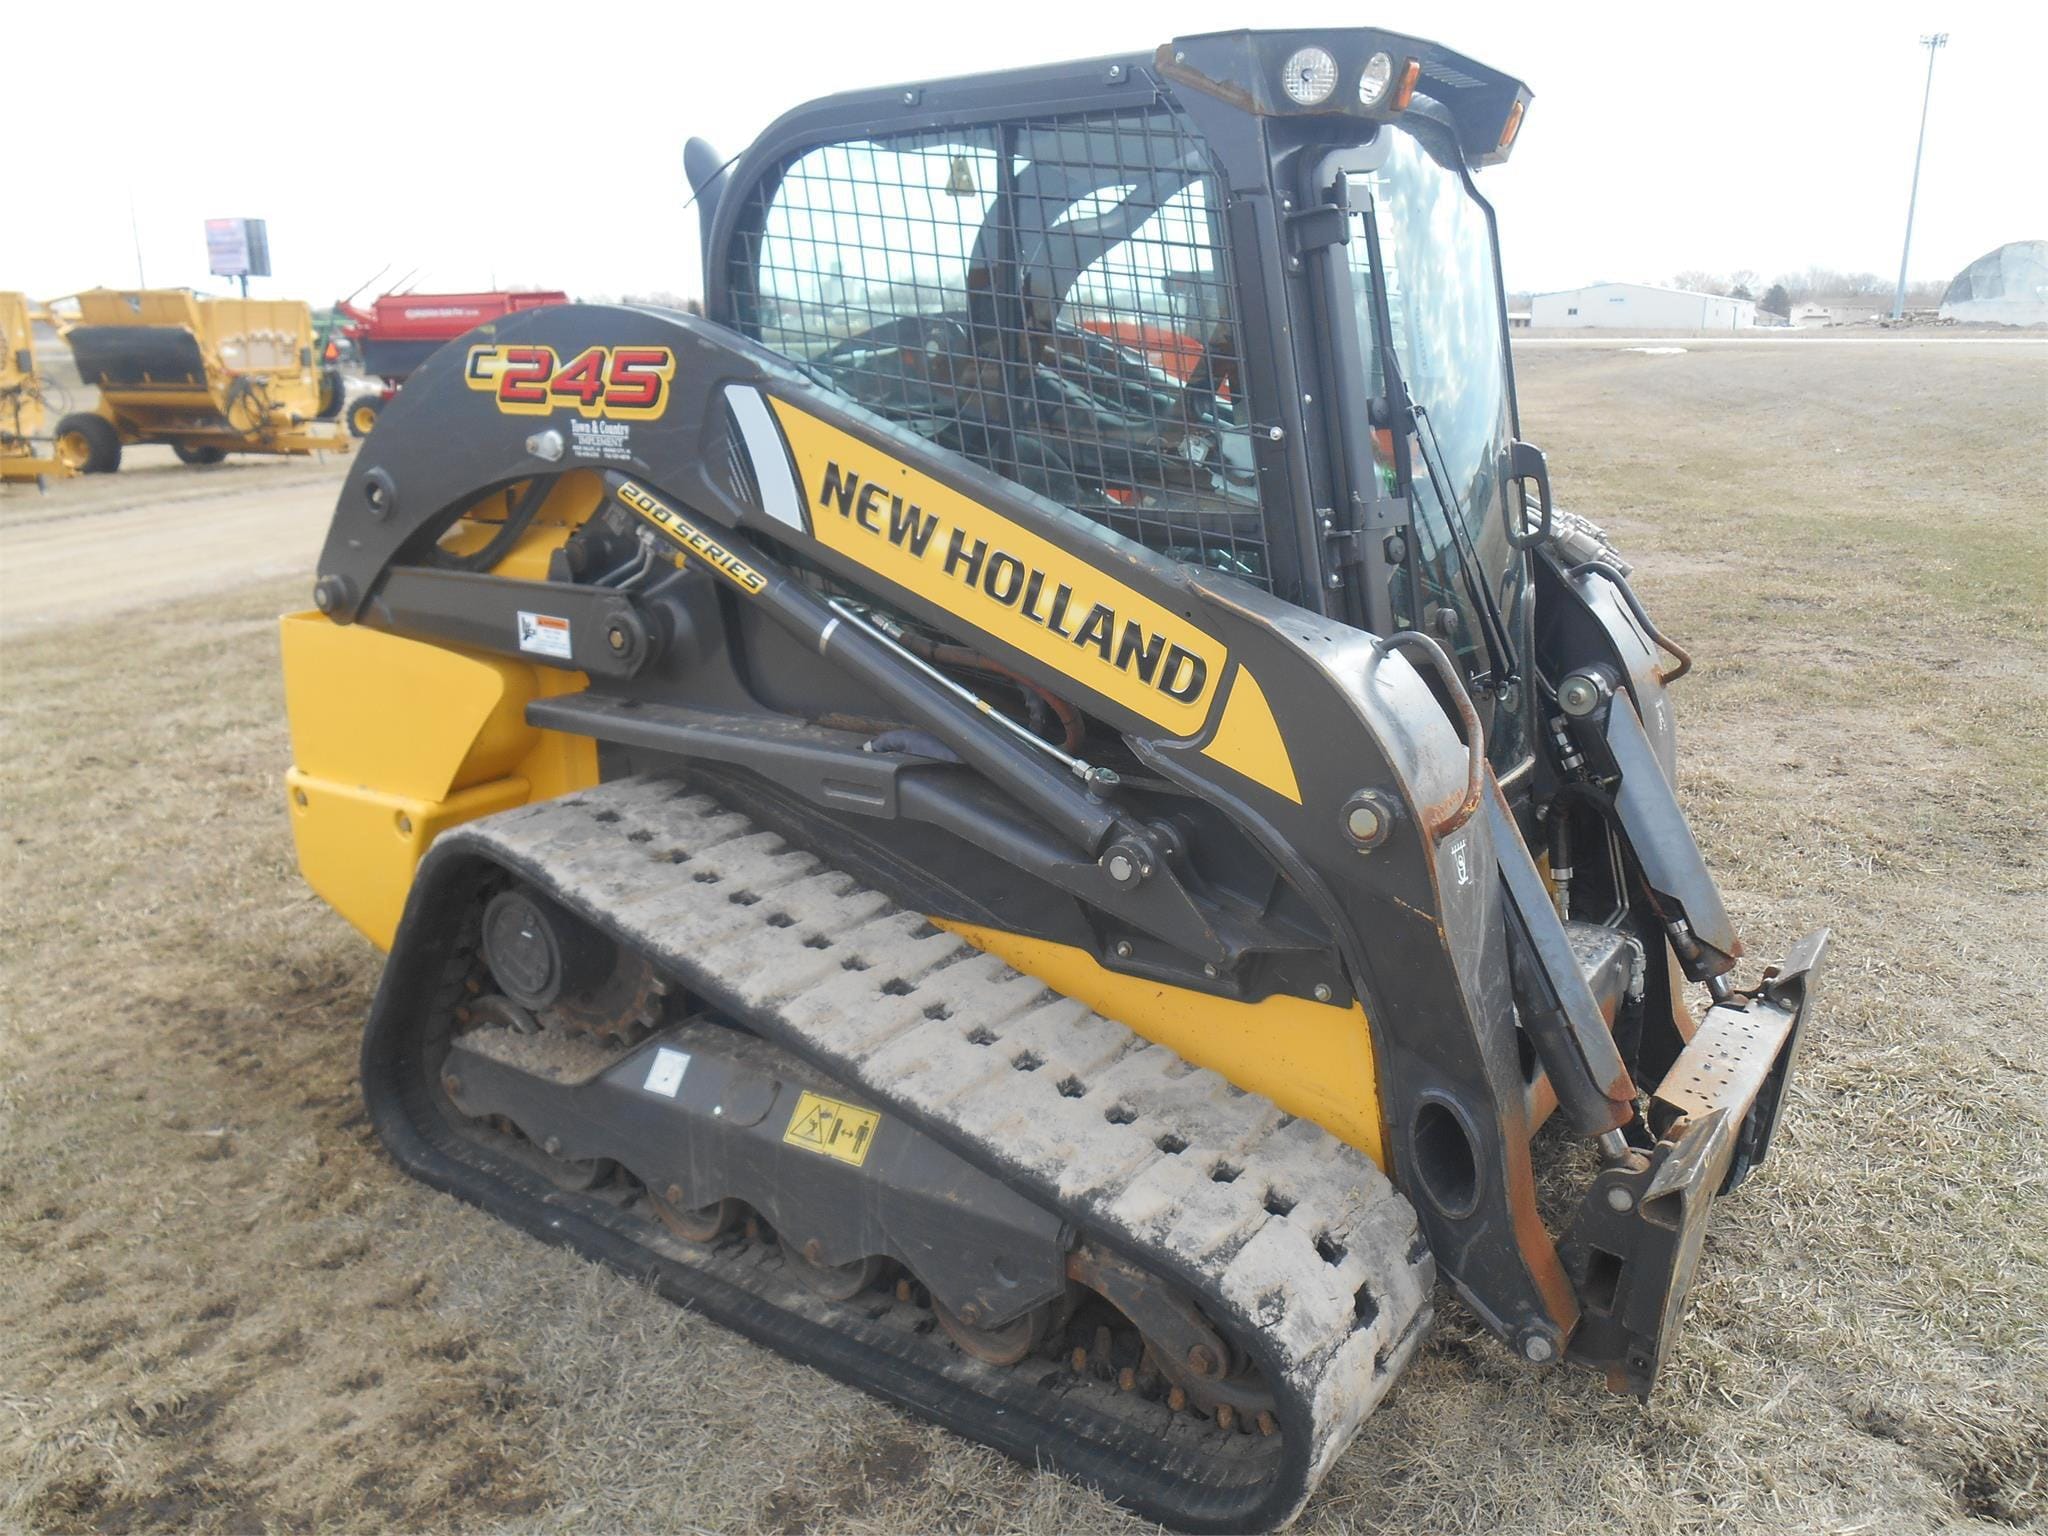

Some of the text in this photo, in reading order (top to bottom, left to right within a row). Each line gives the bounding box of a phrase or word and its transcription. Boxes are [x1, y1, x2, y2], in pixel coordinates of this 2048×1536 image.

[467, 345, 673, 413] C245
[570, 418, 630, 439] Town & Country
[578, 435, 623, 447] IMPLEMENT
[621, 482, 765, 589] 200 SERIES
[818, 459, 1209, 706] NEW HOLLAND
